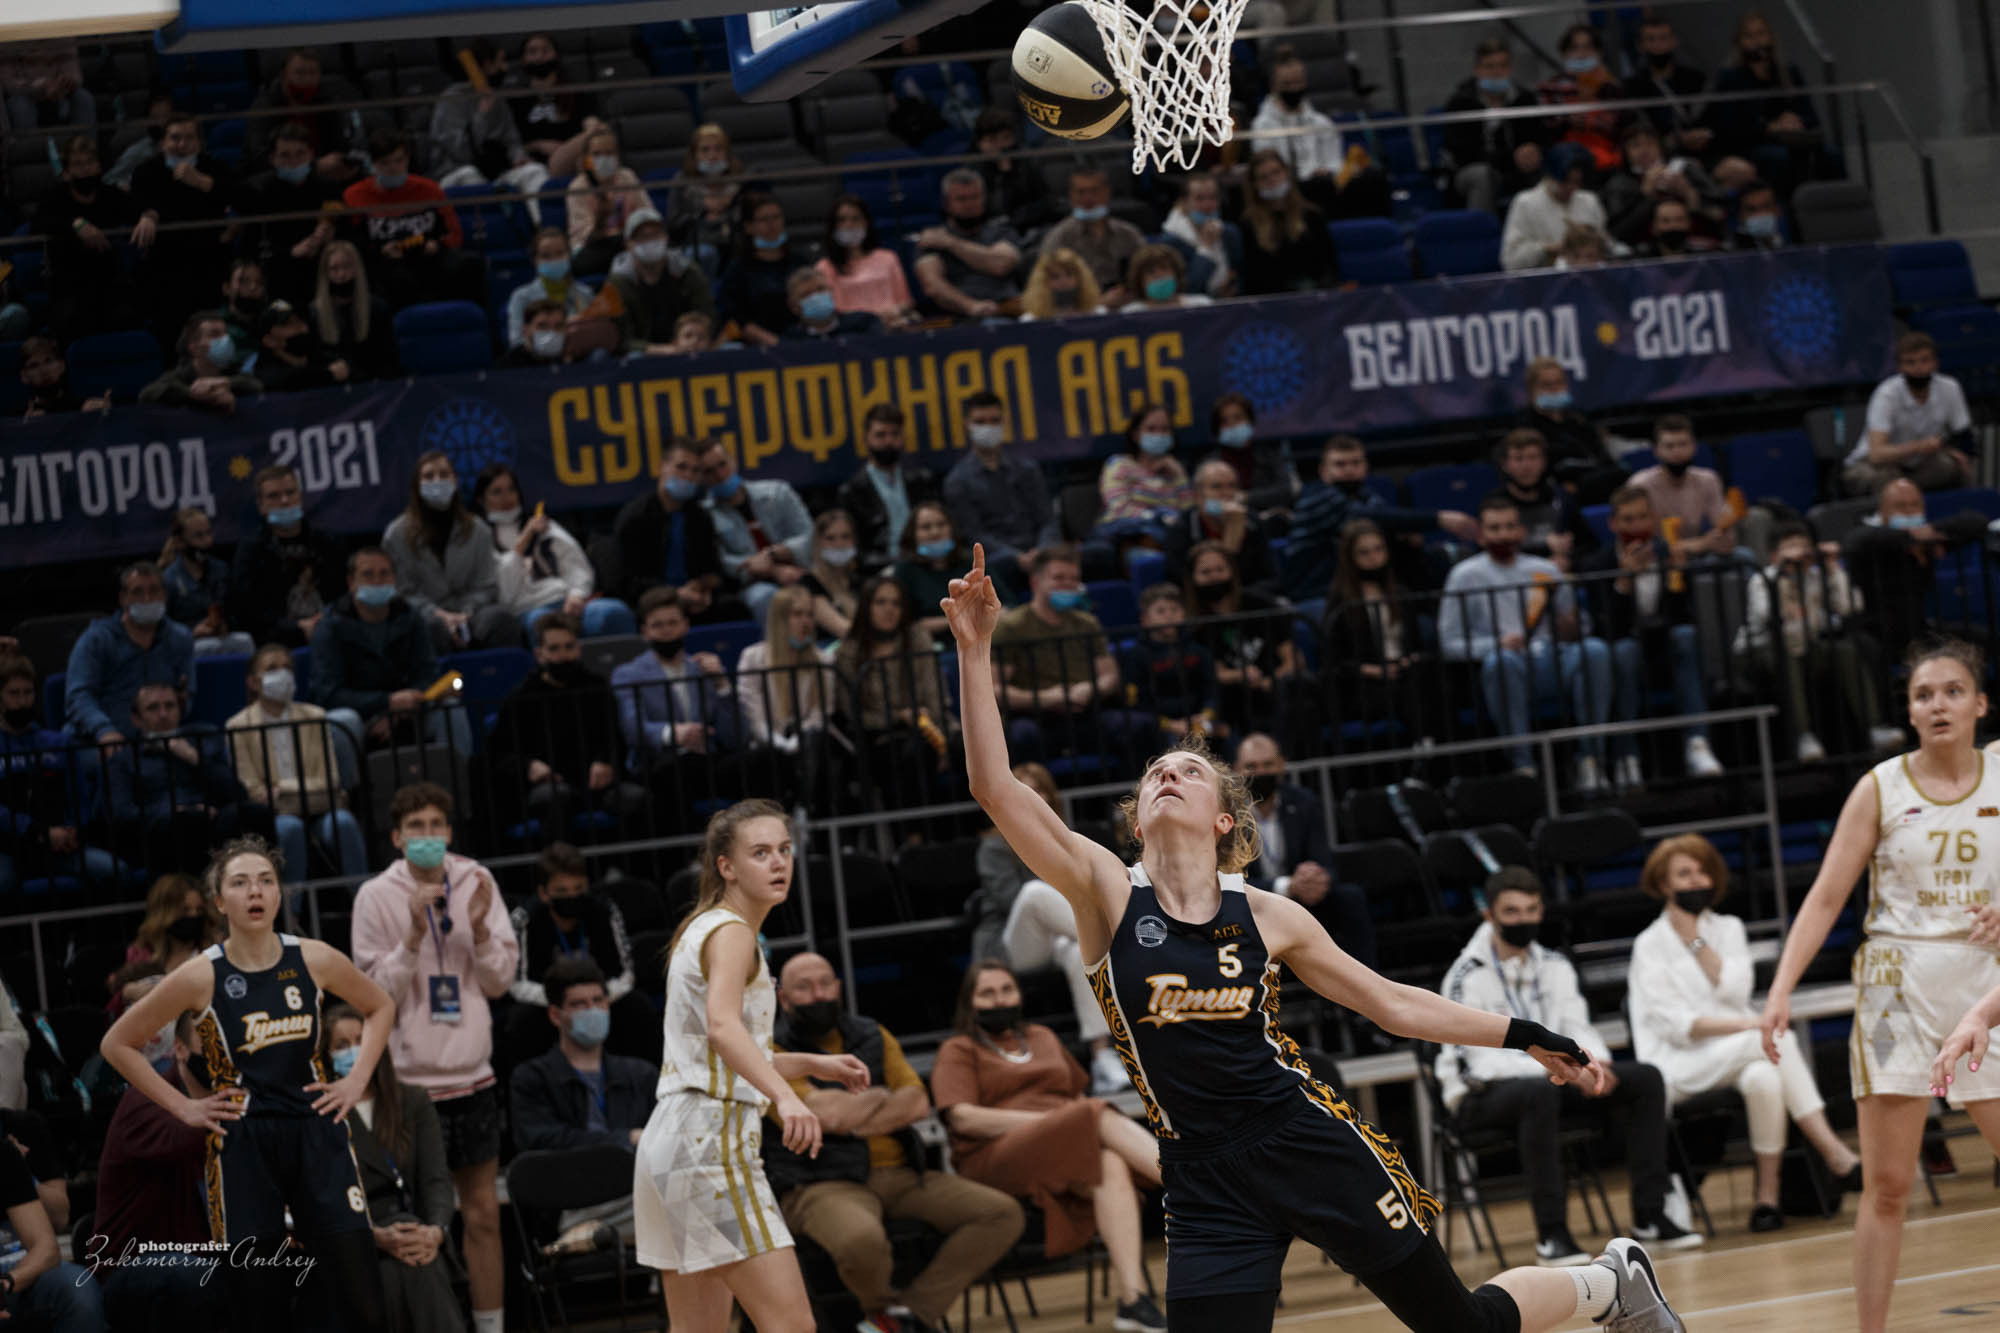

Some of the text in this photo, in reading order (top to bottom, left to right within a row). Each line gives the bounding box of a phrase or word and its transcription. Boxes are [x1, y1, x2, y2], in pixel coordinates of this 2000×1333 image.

[1343, 289, 1732, 391] БЕЛГОРОД 2021
[549, 331, 1194, 487] СУПЕРФИНАЛ АСБ
[0, 419, 381, 527] ЛГОРОД 2021
[1928, 830, 1978, 865] 76
[1217, 943, 1243, 979] 5
[284, 984, 304, 1011] 6
[346, 1184, 365, 1212] 6
[1376, 1188, 1409, 1231] 5
